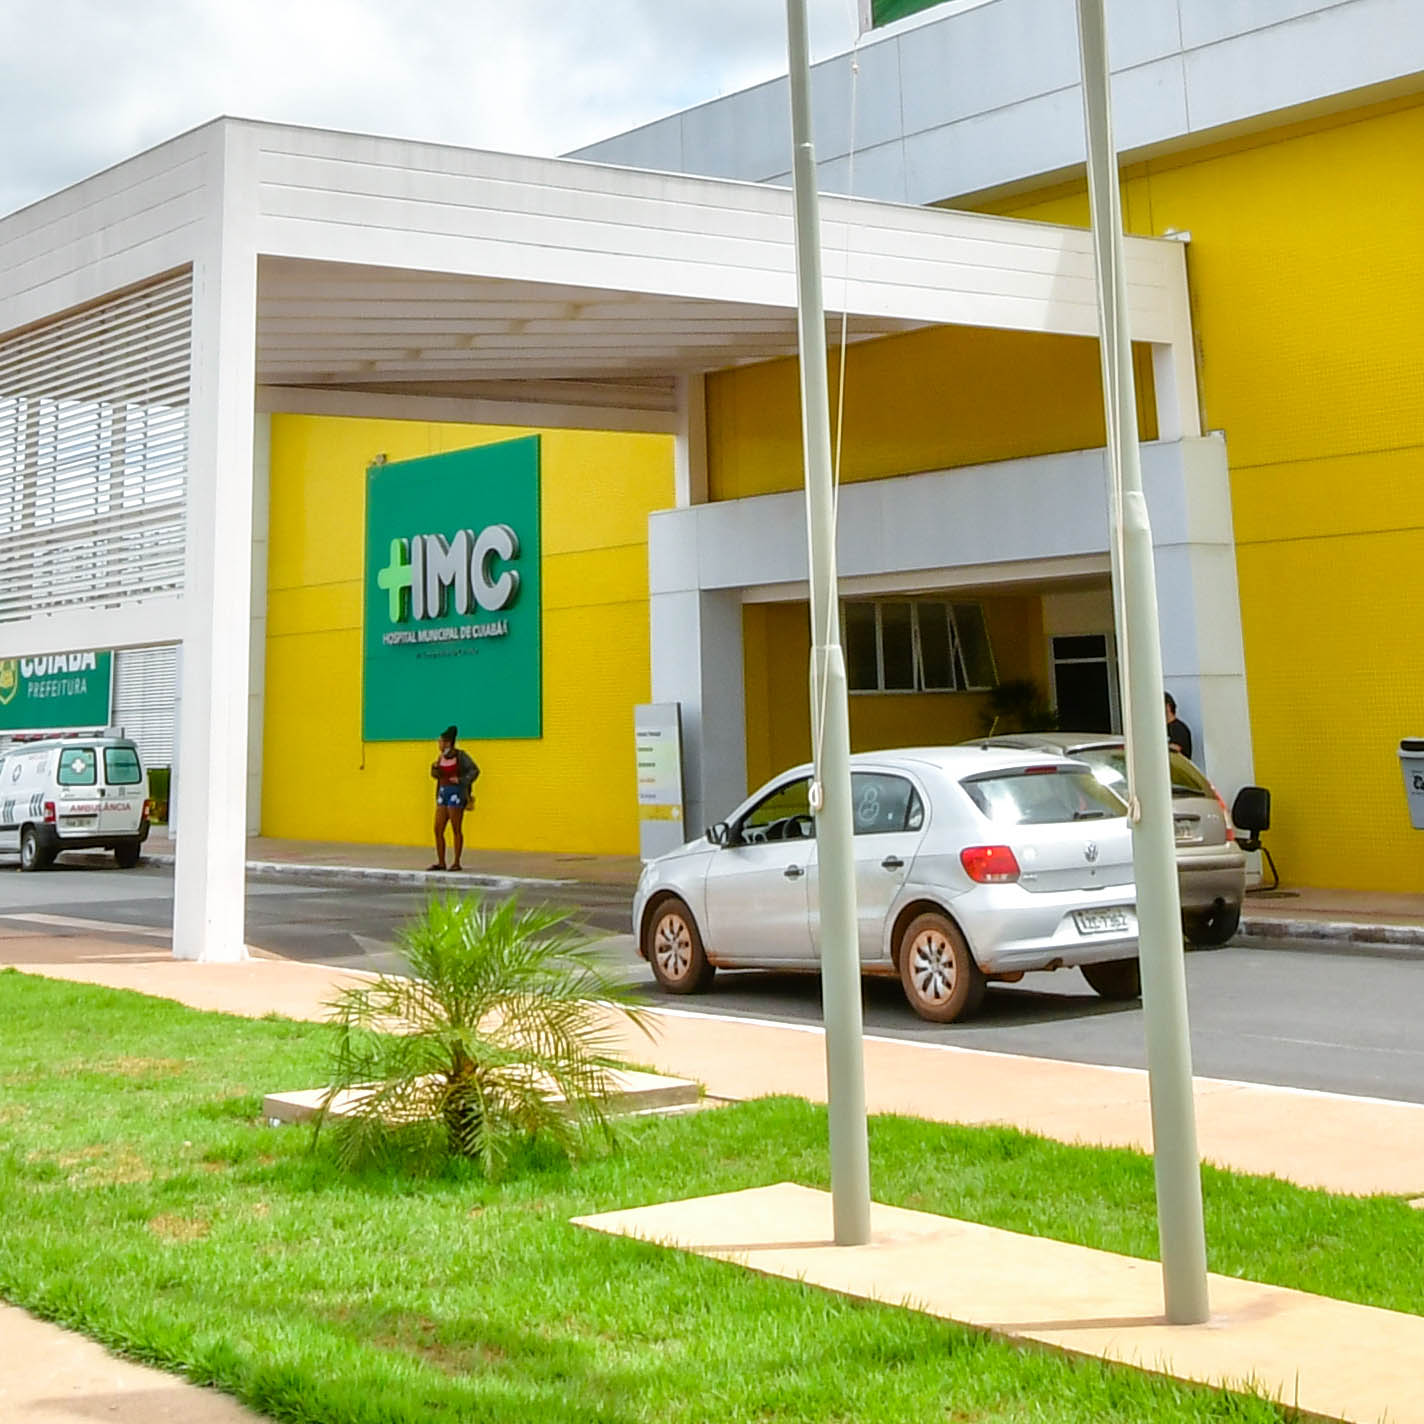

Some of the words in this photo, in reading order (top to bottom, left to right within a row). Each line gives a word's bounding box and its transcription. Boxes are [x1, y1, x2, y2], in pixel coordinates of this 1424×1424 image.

[383, 631, 417, 645] HOSPITAL
[417, 627, 458, 643] MUNICIPAL
[459, 626, 472, 640] DE
[27, 678, 87, 698] PREFEITURA
